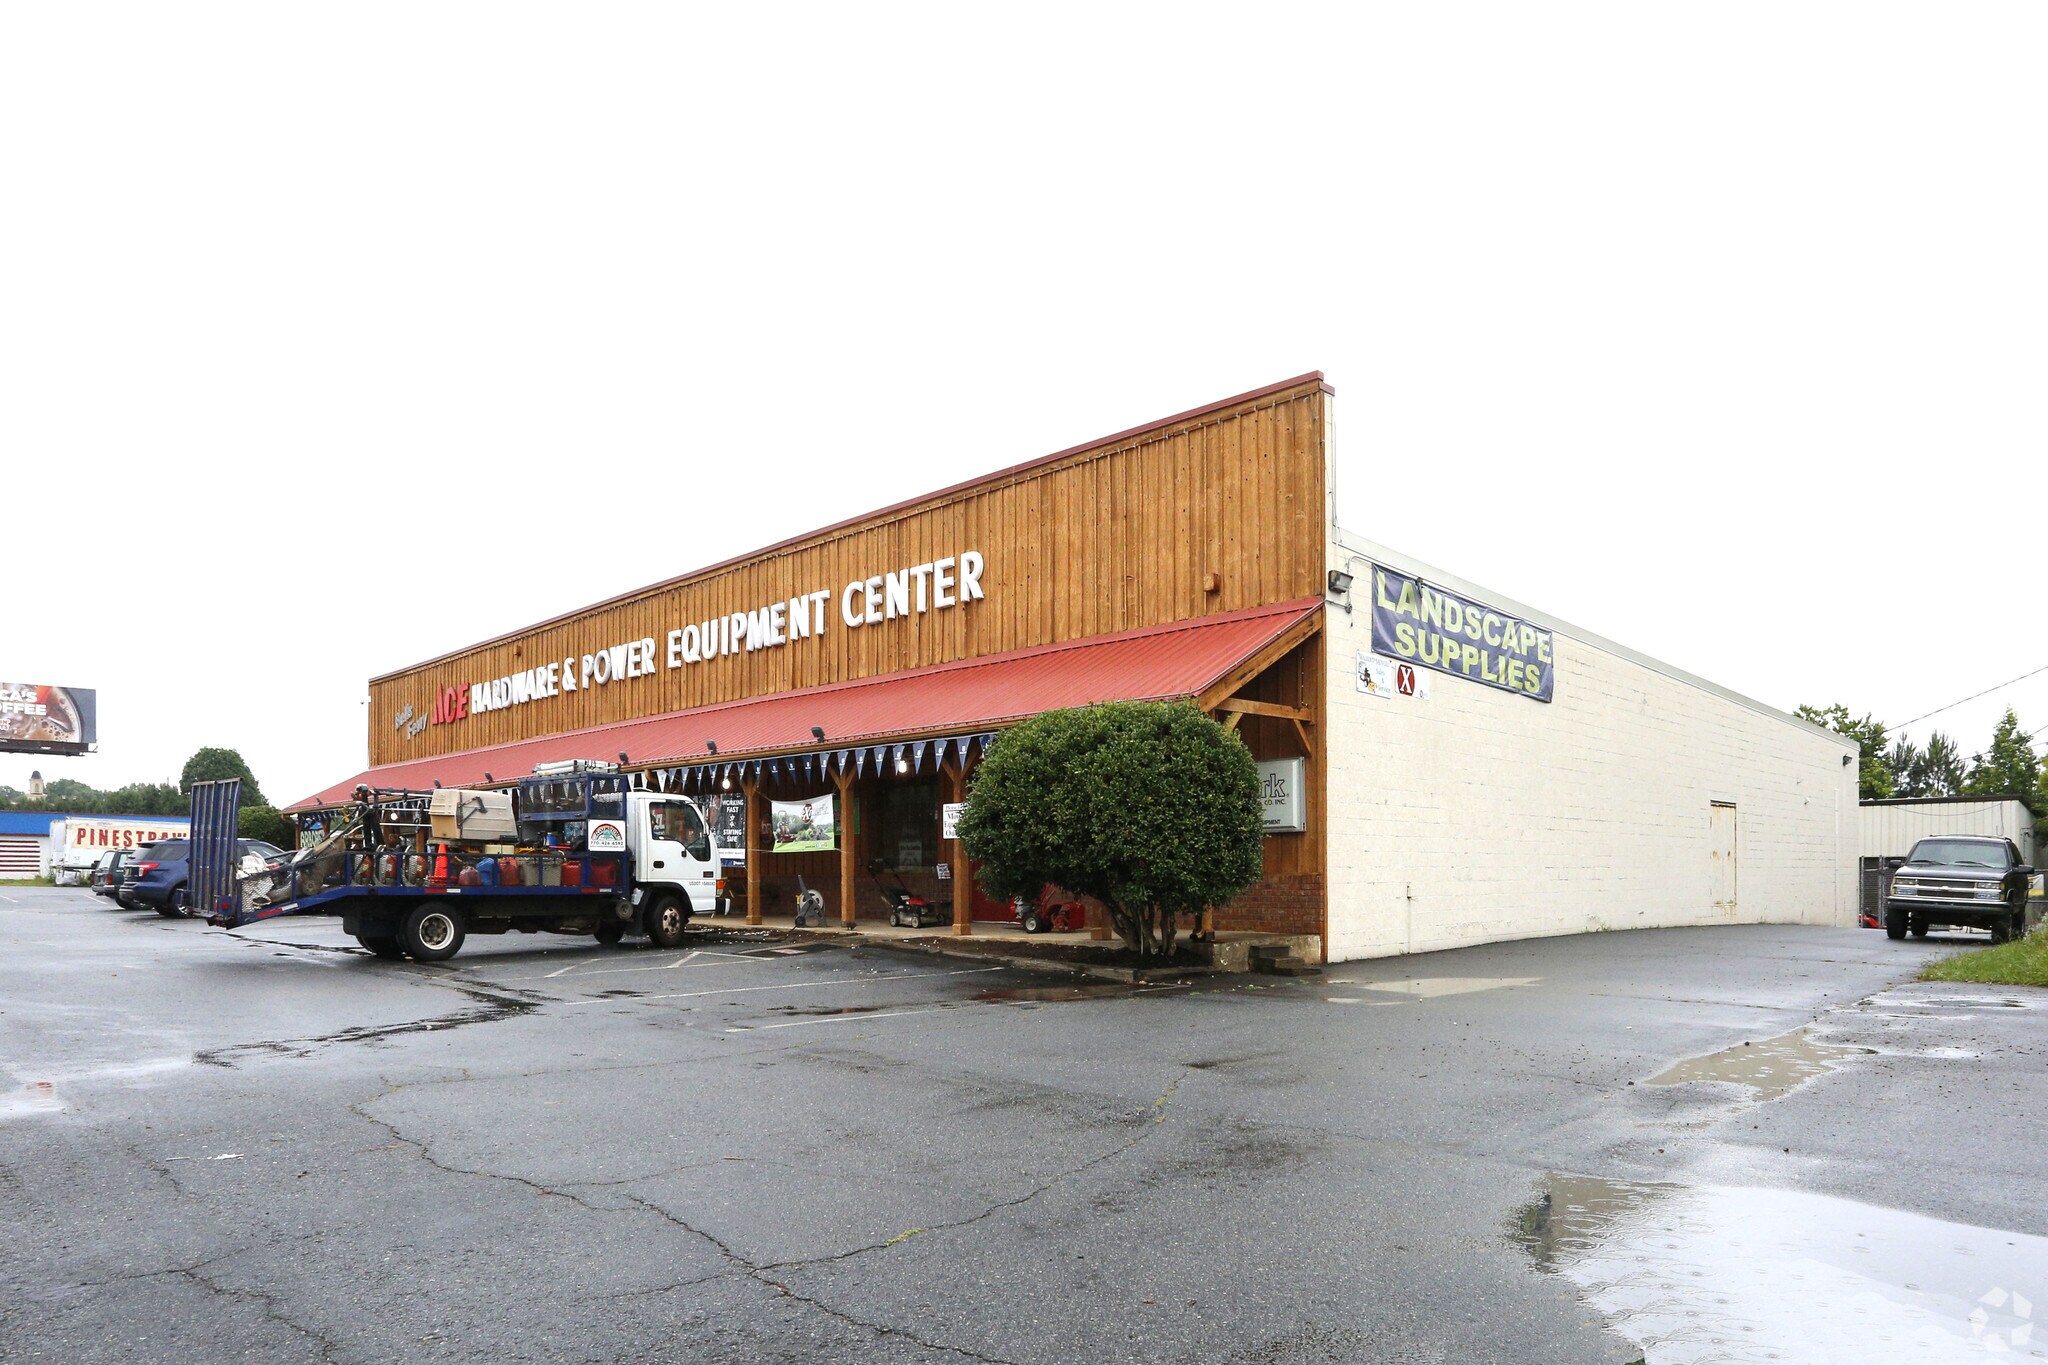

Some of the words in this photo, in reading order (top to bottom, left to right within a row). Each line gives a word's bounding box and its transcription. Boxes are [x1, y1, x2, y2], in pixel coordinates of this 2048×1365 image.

[432, 682, 470, 725] ACE
[471, 663, 559, 715] HARDWARE
[562, 657, 577, 692] &
[582, 637, 656, 690] POWER
[667, 589, 831, 669] EQUIPMENT
[841, 550, 985, 628] CENTER
[1376, 570, 1552, 664] LANDSCAPE
[1394, 622, 1541, 693] SUPPLIES
[0, 702, 47, 716] FFEE
